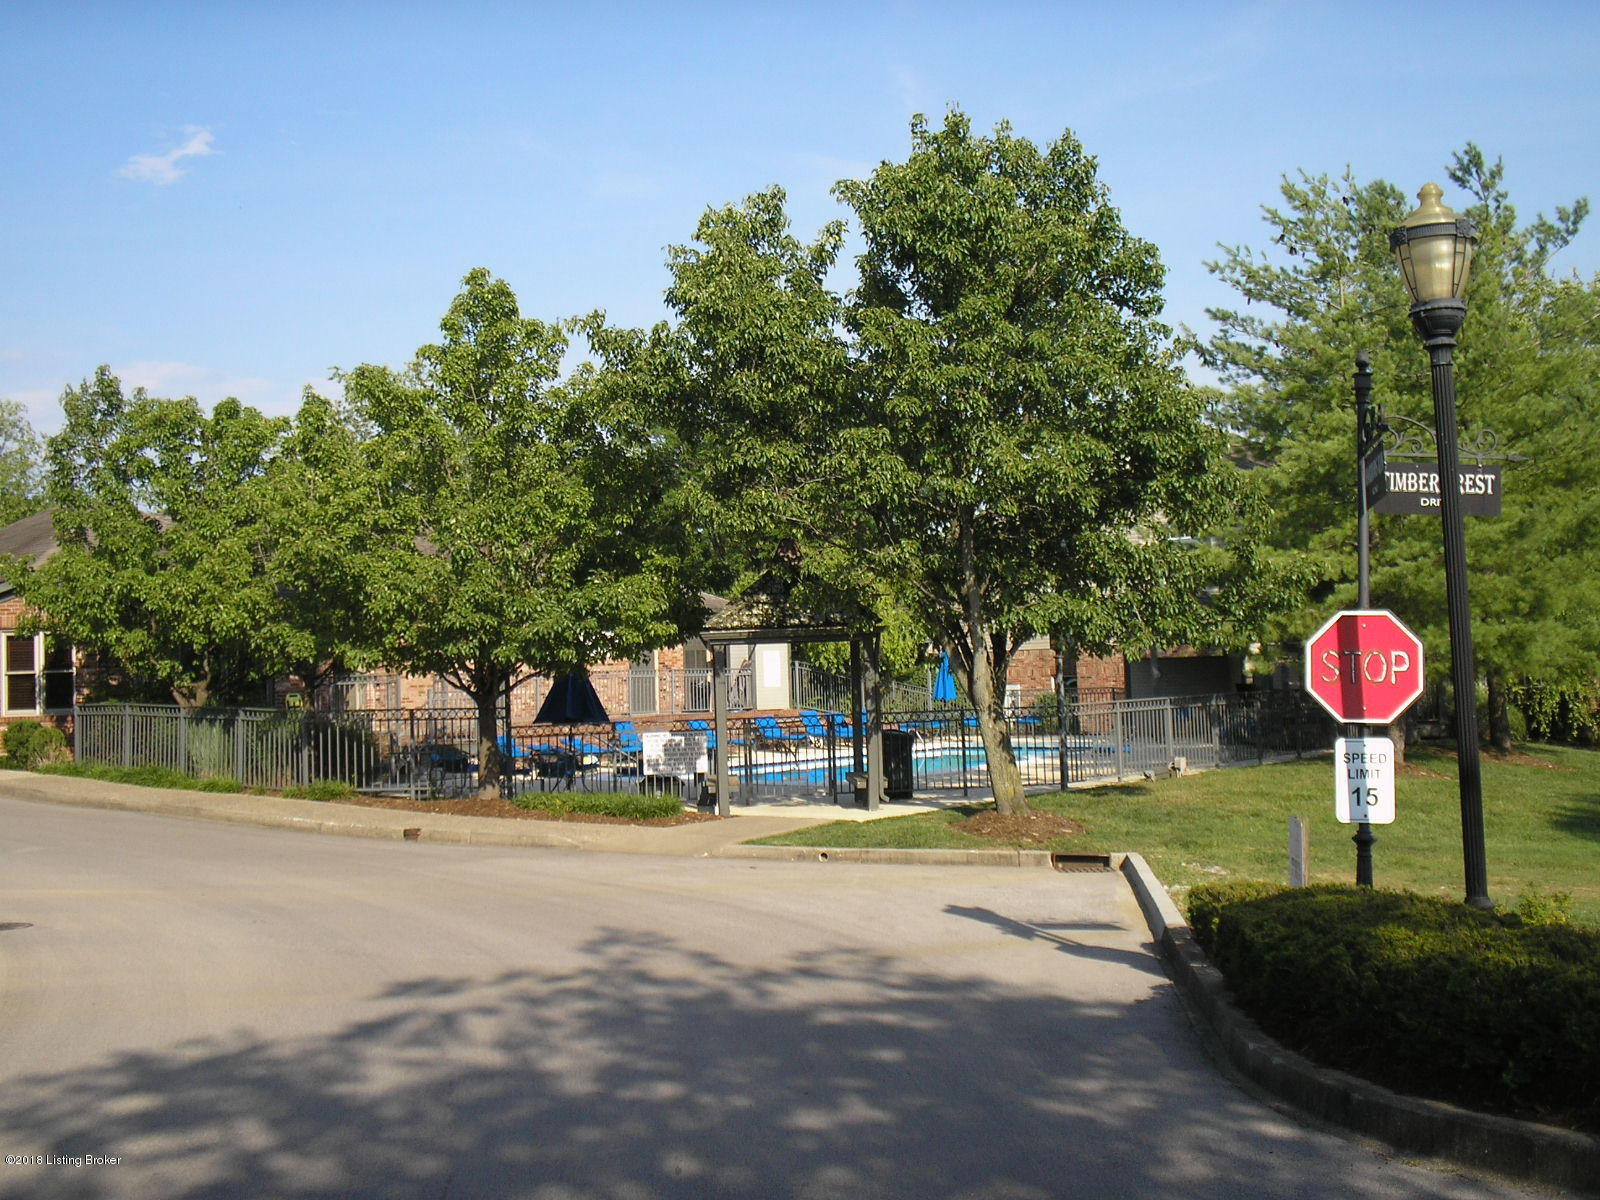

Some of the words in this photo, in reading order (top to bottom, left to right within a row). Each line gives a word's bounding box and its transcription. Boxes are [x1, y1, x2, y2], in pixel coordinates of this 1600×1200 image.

[1420, 497, 1442, 507] DRI
[1320, 649, 1411, 686] STOP
[1343, 752, 1387, 764] SPEED
[1347, 769, 1382, 780] LIMIT
[1351, 786, 1379, 806] 15
